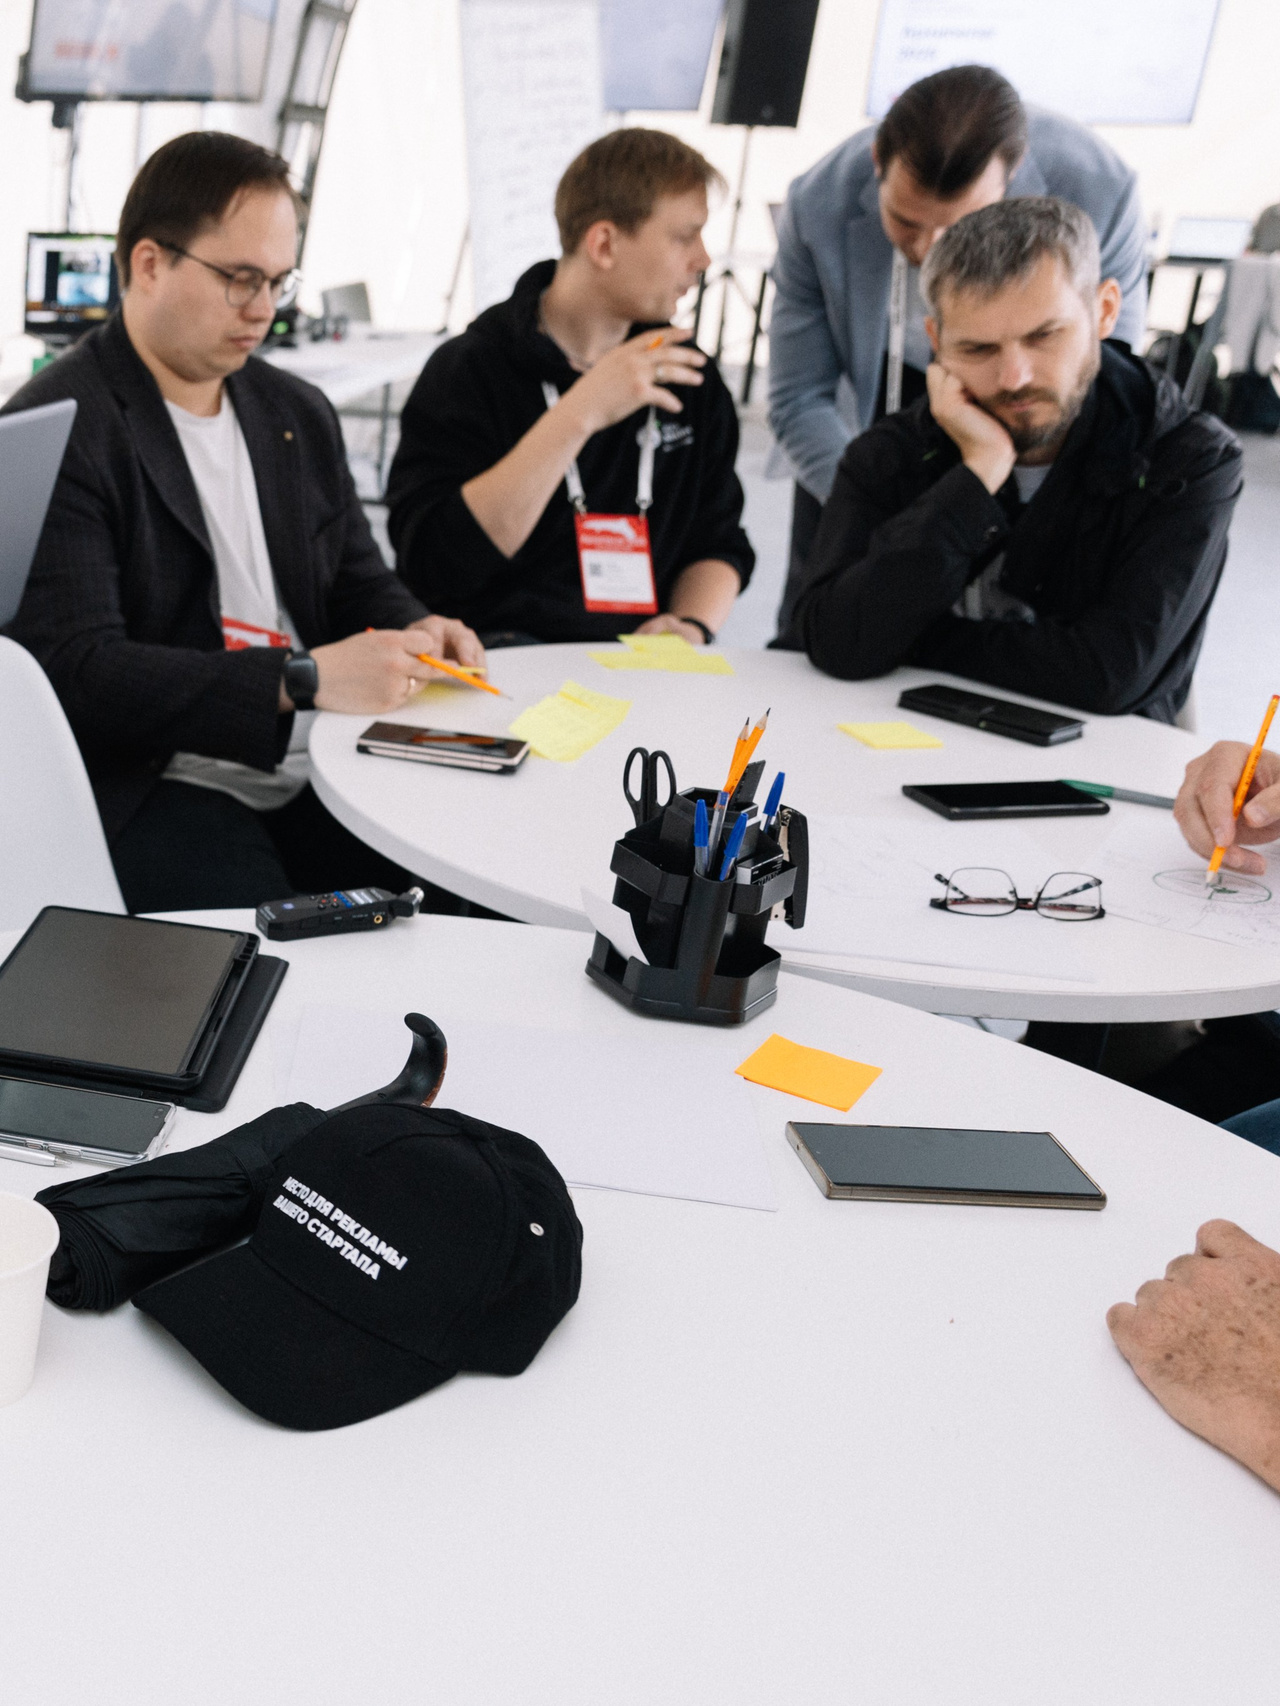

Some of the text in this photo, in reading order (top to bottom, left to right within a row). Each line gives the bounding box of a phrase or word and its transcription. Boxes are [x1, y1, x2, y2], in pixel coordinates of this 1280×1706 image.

[272, 1194, 381, 1281] ВАШЕГО СТАРТАПА
[282, 1176, 409, 1271] МЕСТО ДЛЯ РЕКЛАМЫ
